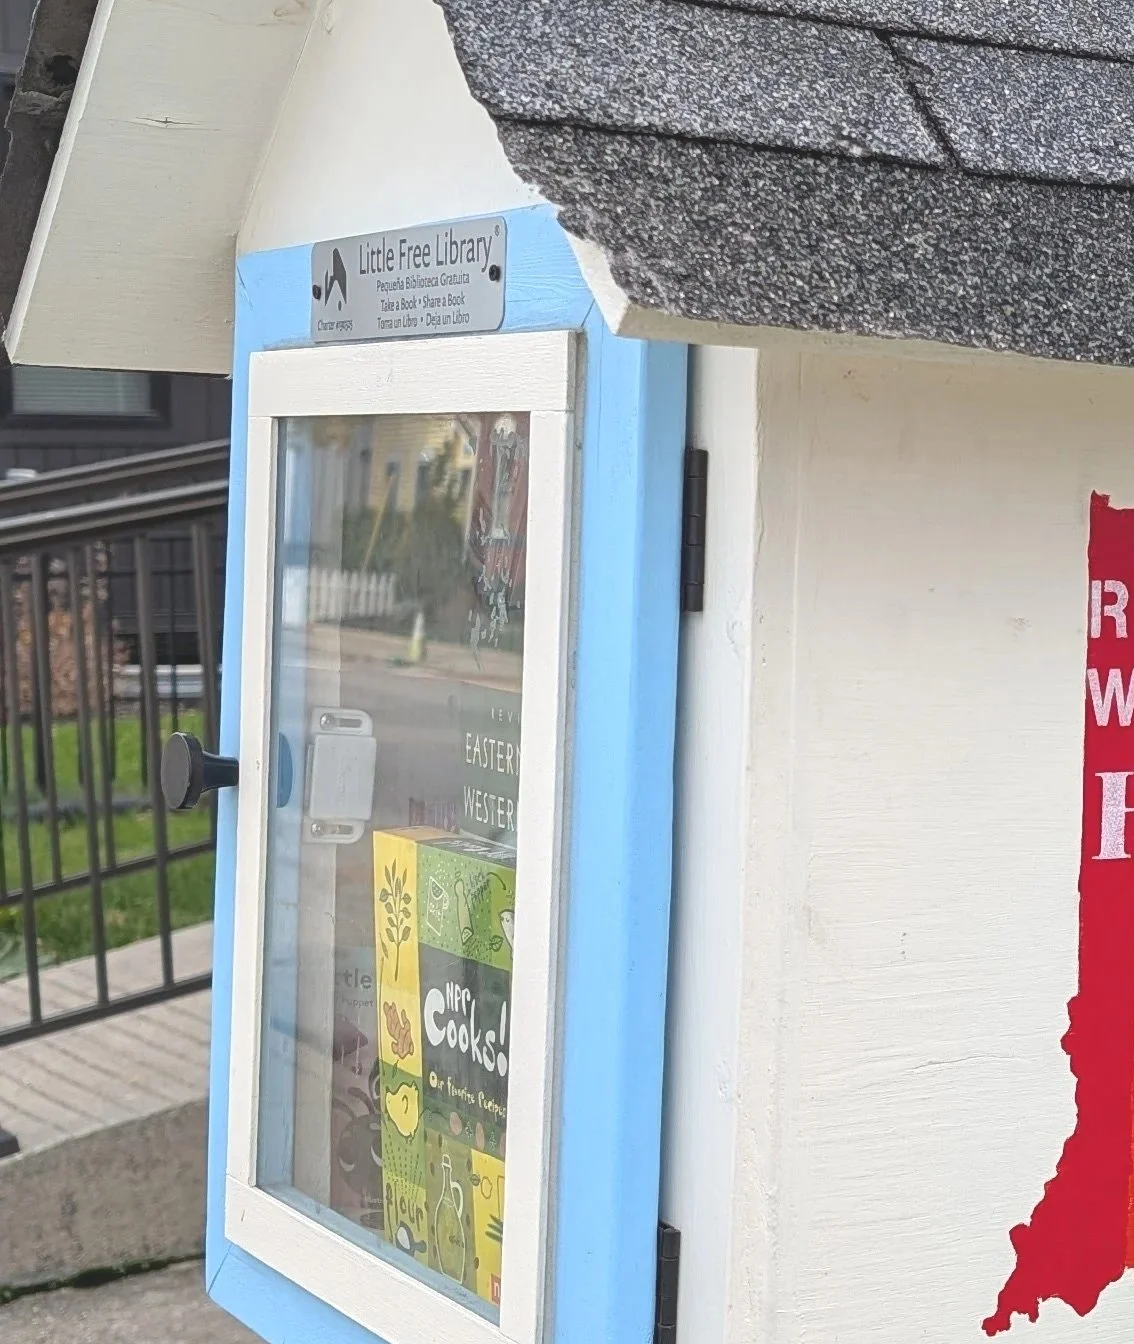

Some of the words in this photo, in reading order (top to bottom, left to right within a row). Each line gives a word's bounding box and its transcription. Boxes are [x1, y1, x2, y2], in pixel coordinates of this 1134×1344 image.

[359, 236, 395, 274] Little
[399, 238, 430, 270] Free
[376, 277, 404, 295] Pequeña
[405, 274, 439, 289] Biblioteca
[440, 270, 470, 287] Gratuita
[380, 297, 394, 312] Take
[400, 295, 417, 311] Book
[422, 294, 441, 308] Share
[447, 290, 466, 307] Book
[402, 313, 418, 328] Libro
[426, 312, 441, 330] Deja
[452, 308, 470, 325] Libro
[463, 785, 519, 832] WESTER
[424, 988, 508, 1077] Cooks!
[429, 1071, 444, 1092] Our
